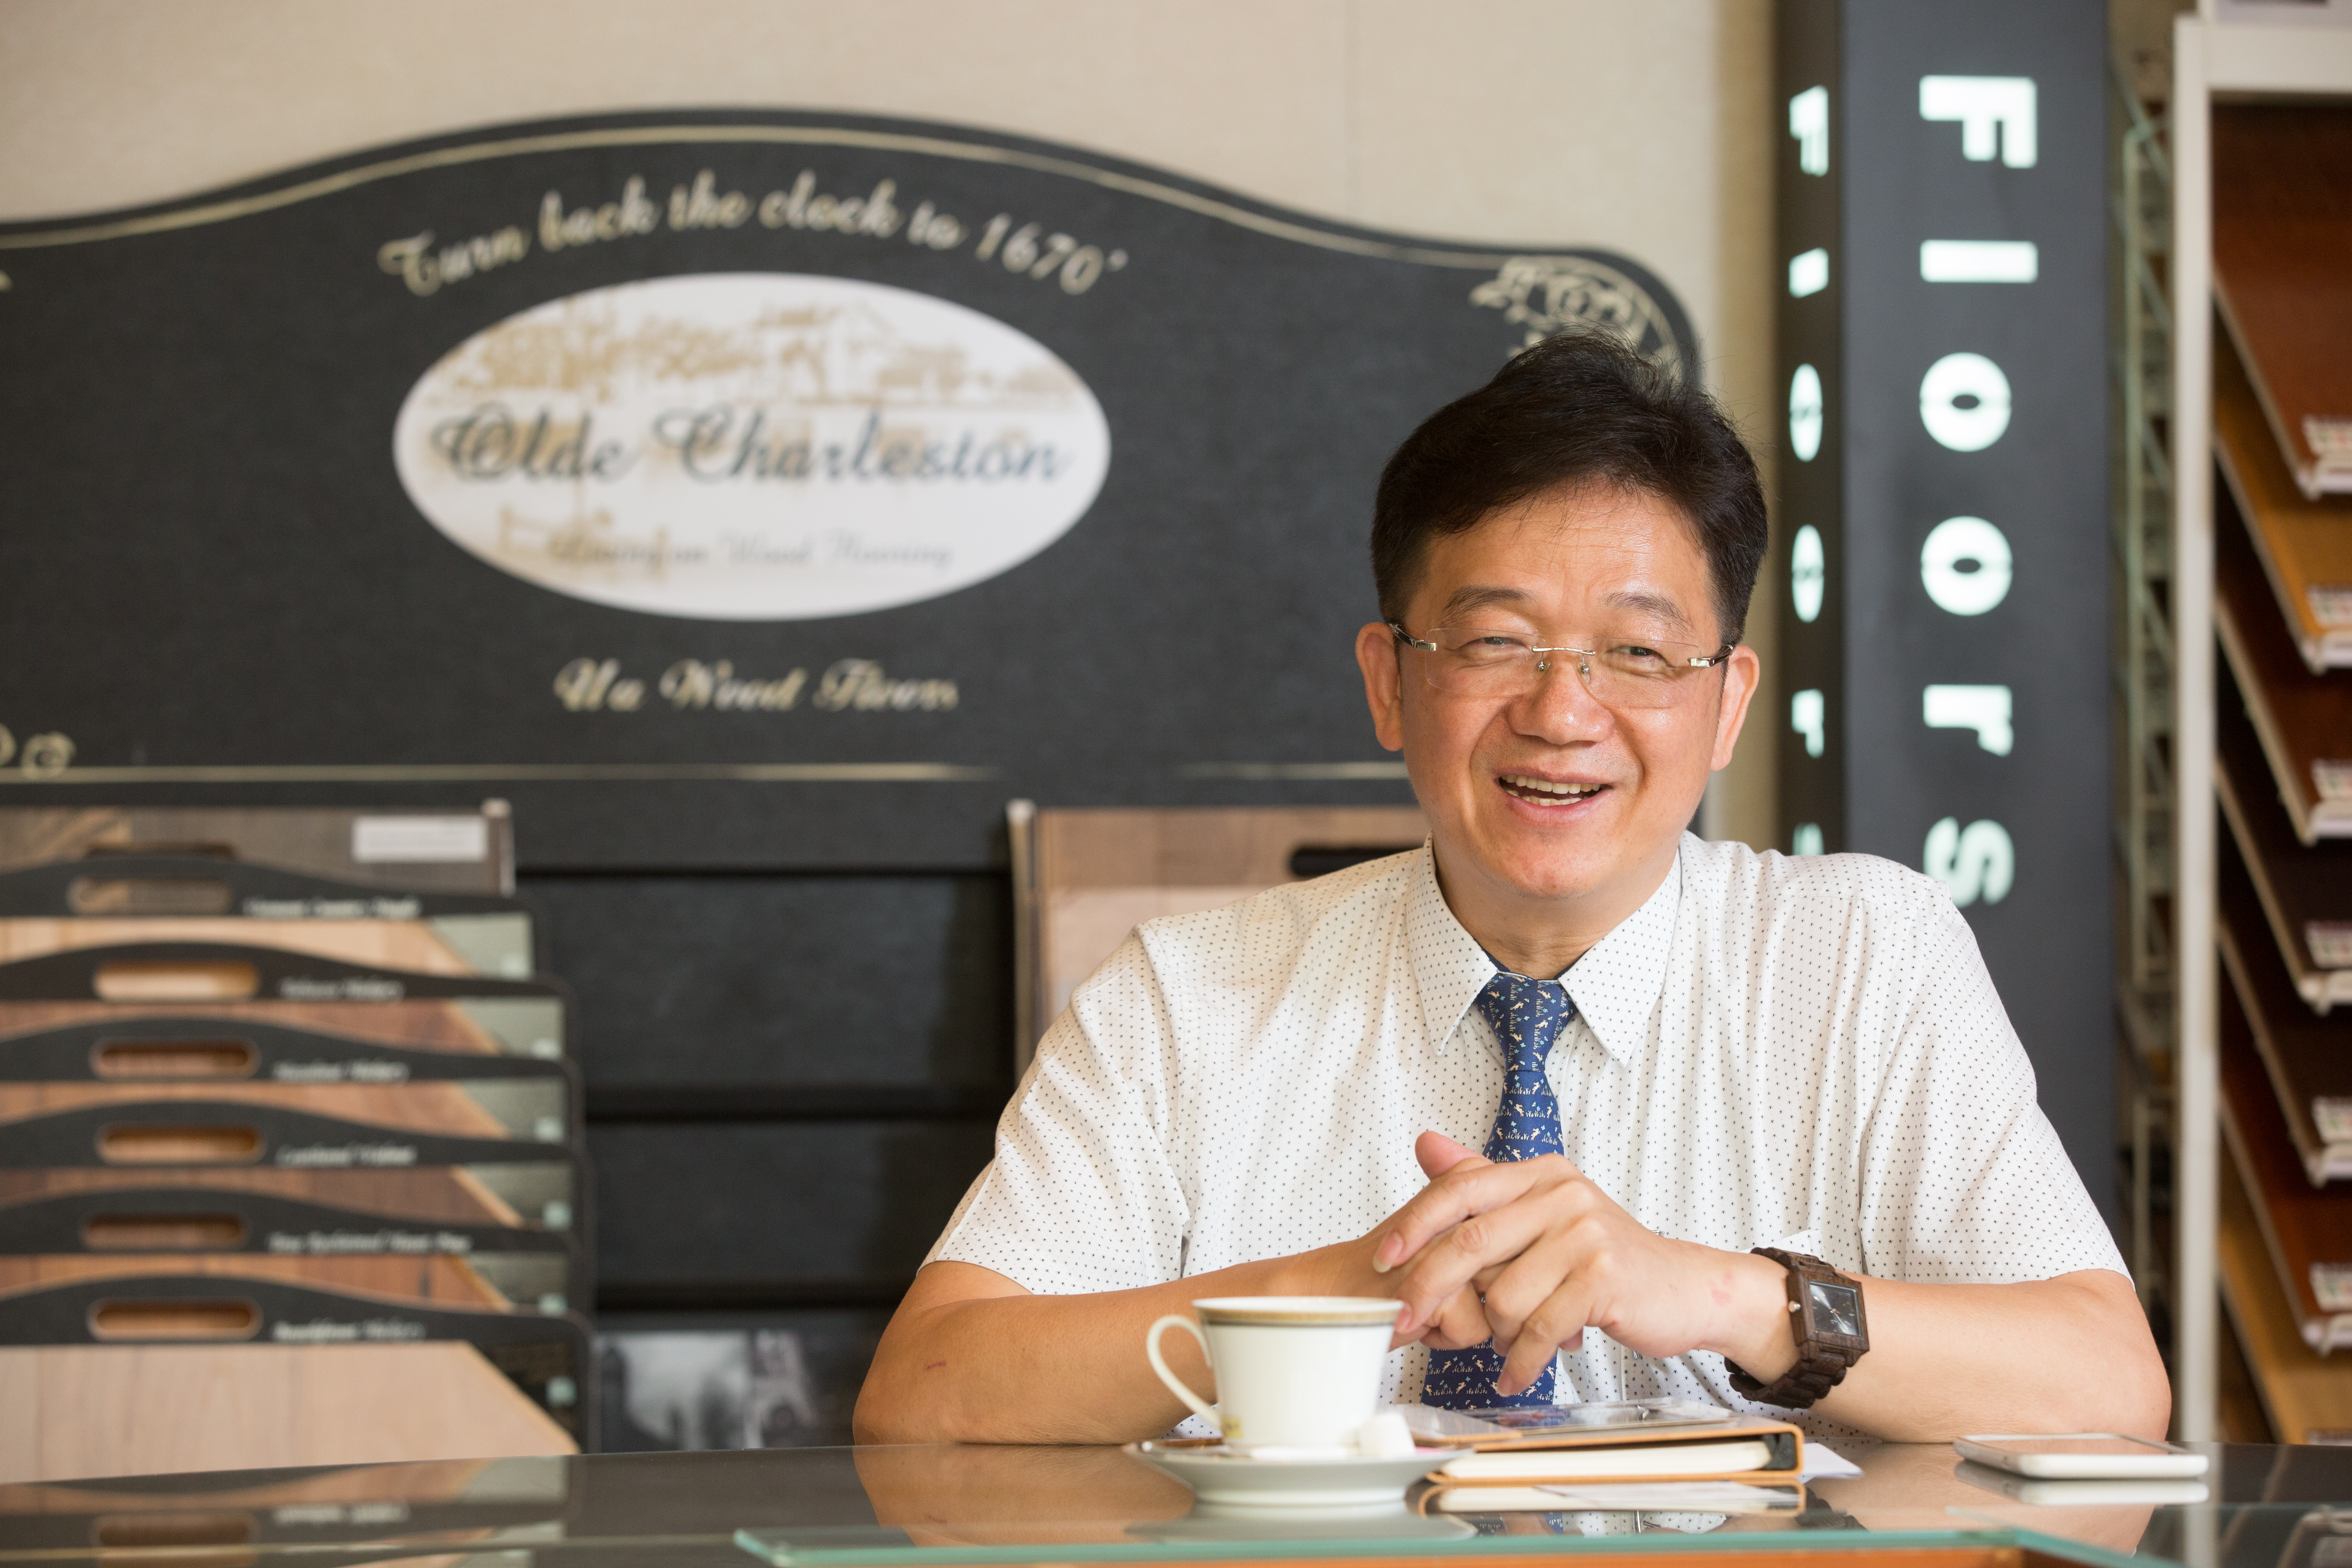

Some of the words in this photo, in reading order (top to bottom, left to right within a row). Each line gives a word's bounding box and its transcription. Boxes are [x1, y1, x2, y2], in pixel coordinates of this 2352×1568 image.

[376, 229, 530, 297] Turn
[538, 174, 662, 252] back
[668, 169, 756, 232] the
[758, 169, 905, 238] clock
[907, 200, 969, 250] to
[430, 402, 637, 485] Olde
[650, 402, 1075, 486] Charleston
[658, 658, 808, 711] Wood
[813, 657, 960, 711] Floors
